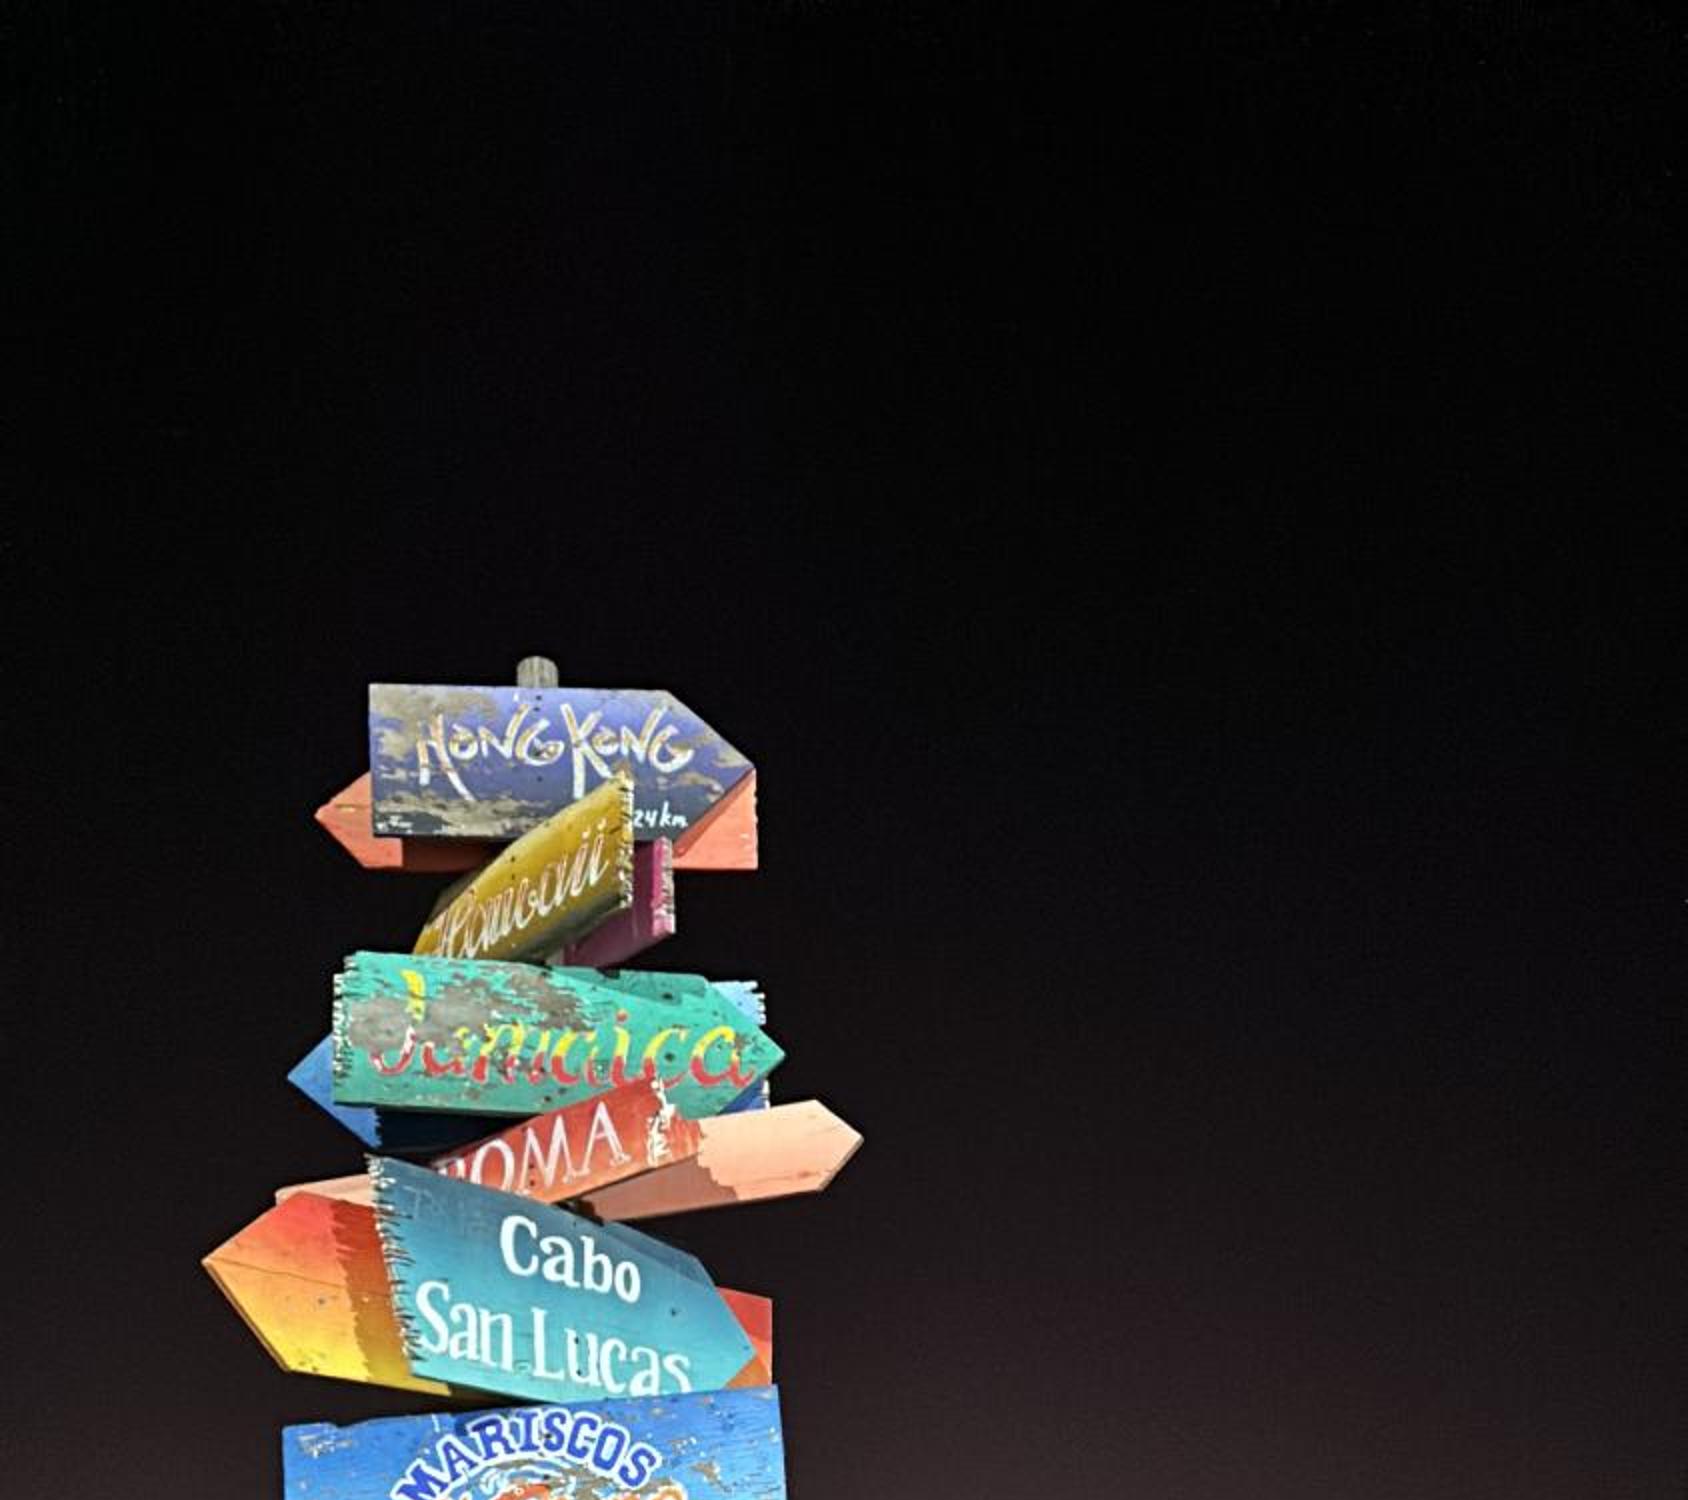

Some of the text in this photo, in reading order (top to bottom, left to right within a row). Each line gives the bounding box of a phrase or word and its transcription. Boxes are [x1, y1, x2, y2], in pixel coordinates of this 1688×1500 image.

[370, 970, 754, 1088] Jamaica
[501, 1215, 641, 1303] Cabo
[415, 1280, 693, 1396] San Lucas
